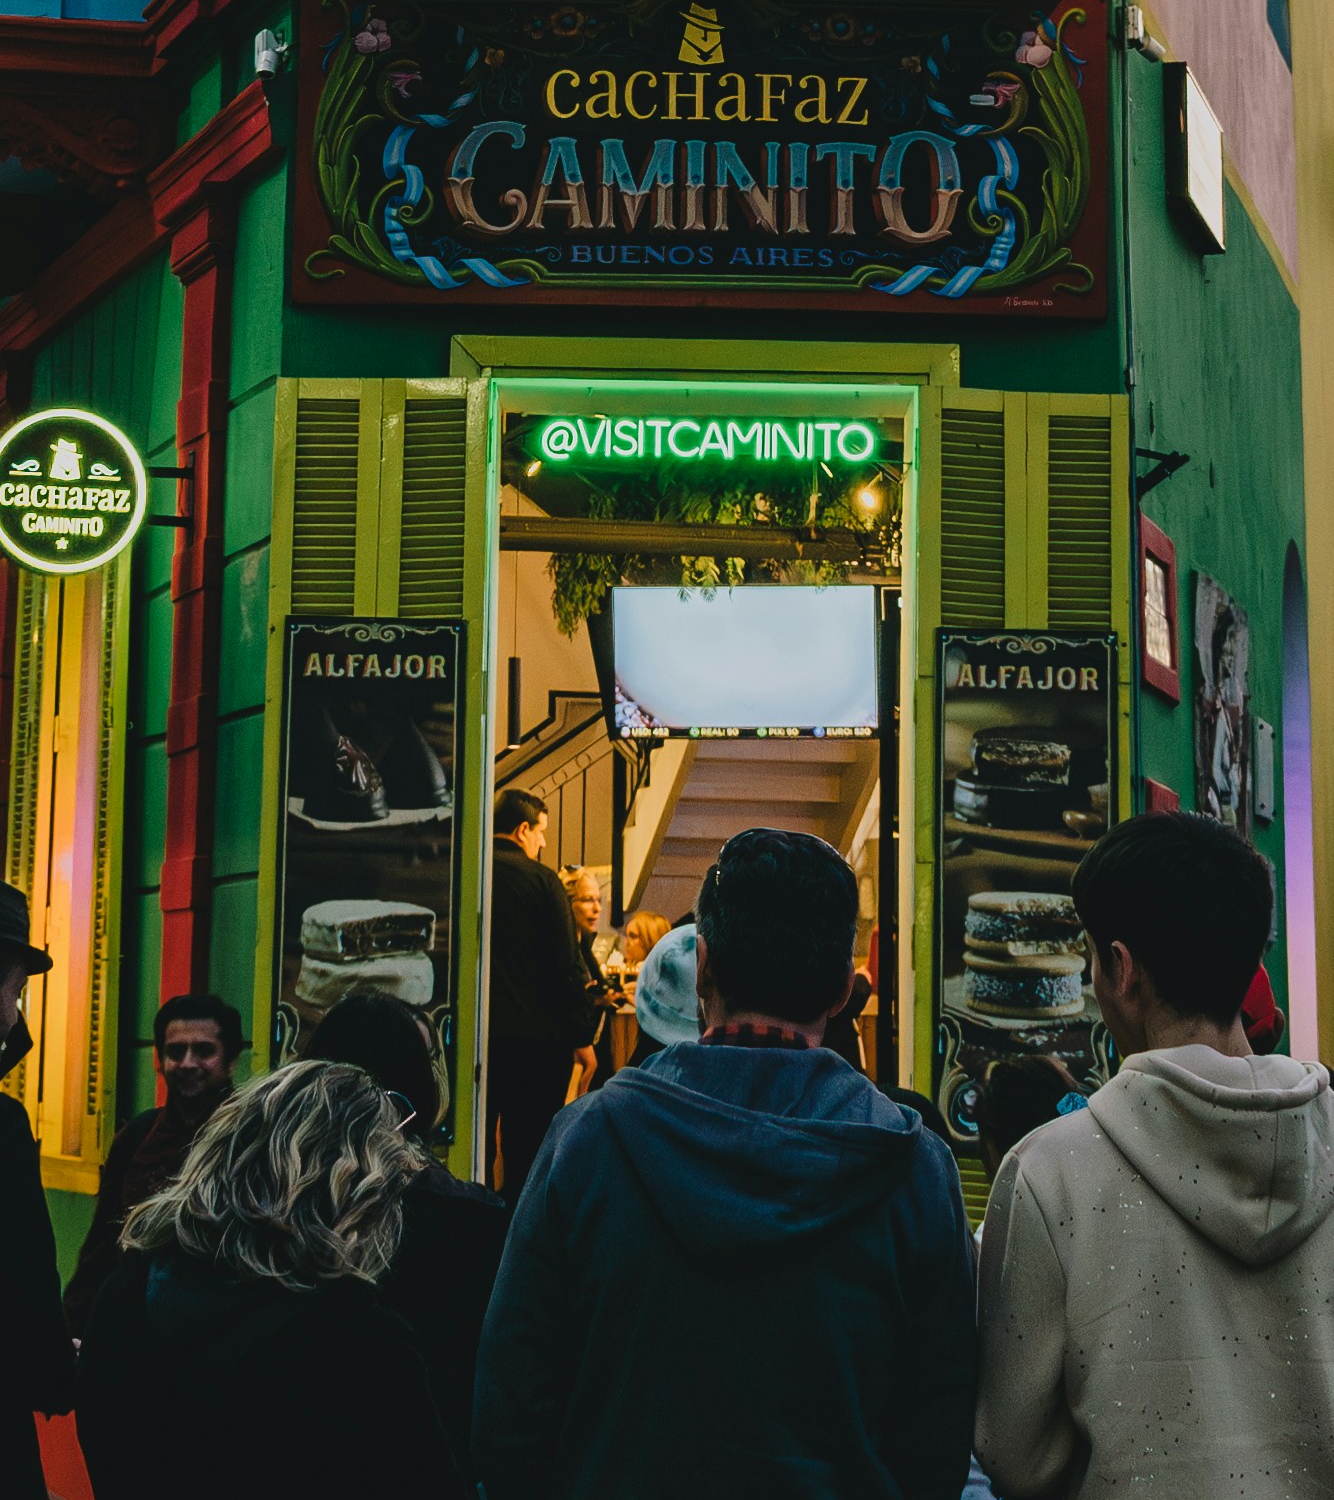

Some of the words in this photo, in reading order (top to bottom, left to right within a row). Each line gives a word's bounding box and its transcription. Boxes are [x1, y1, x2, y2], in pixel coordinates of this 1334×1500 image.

[444, 120, 964, 245] CAMINITO
[570, 245, 715, 266] BUENOS
[729, 247, 835, 268] AIRES
[541, 418, 875, 461] @VISITCAMINITO
[22, 512, 104, 538] CAMINITO
[302, 652, 447, 680] ALFAJOR
[957, 663, 1099, 691] ALFAJOR
